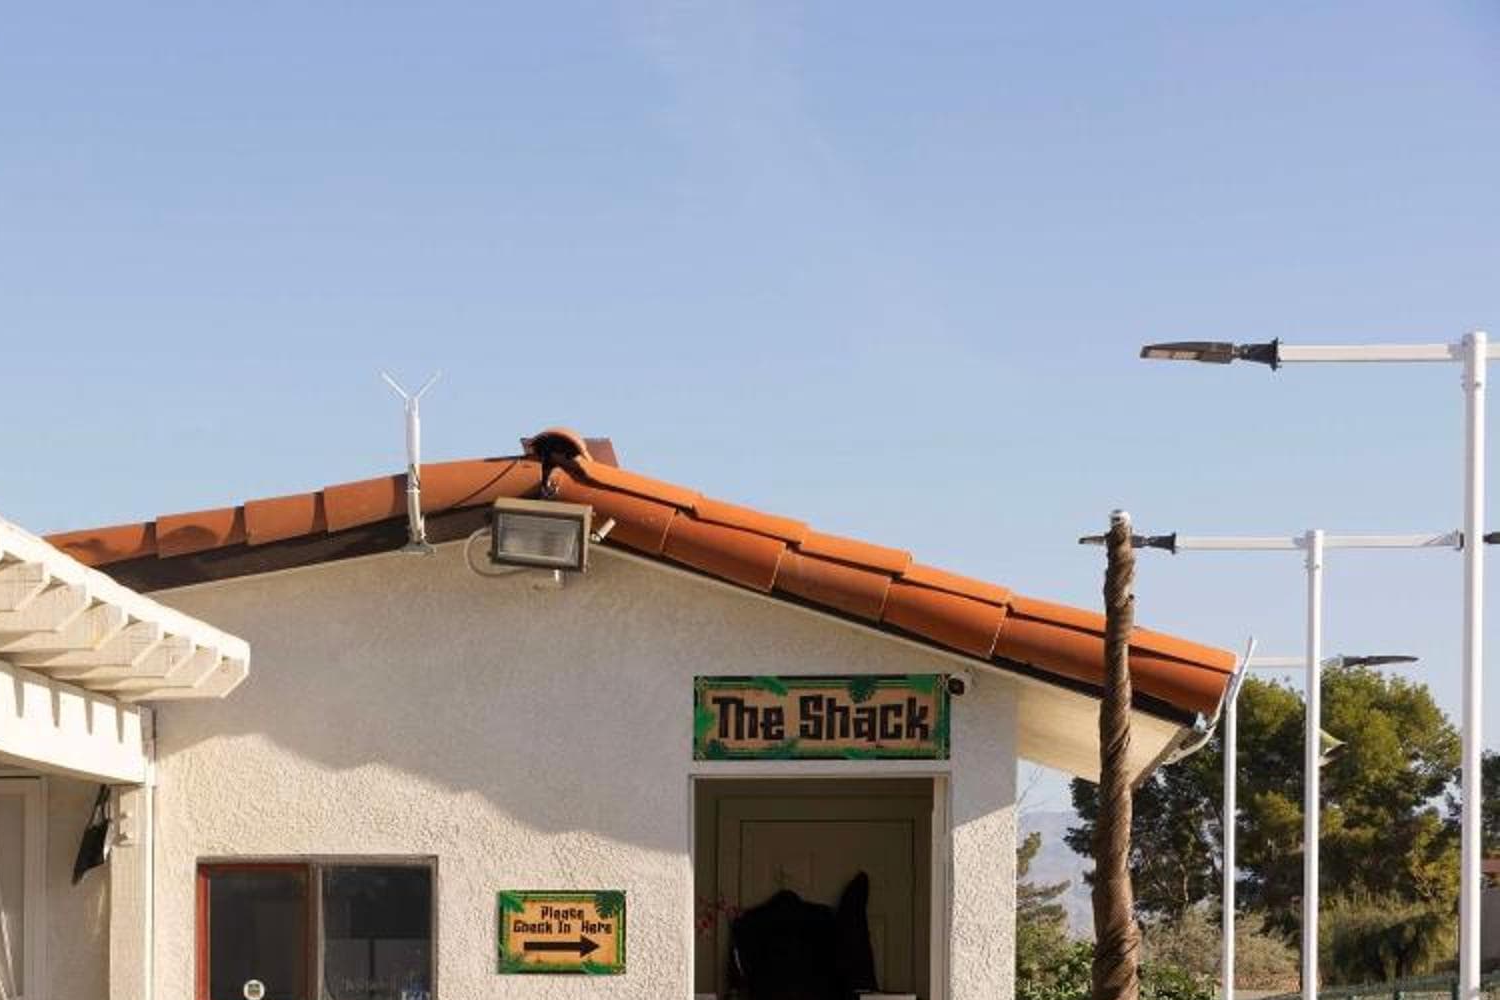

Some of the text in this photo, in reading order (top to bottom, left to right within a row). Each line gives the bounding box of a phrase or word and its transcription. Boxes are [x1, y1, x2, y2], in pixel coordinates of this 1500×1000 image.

[712, 694, 929, 742] The Shack
[541, 906, 584, 920] Please
[513, 920, 612, 934] Check In Here
